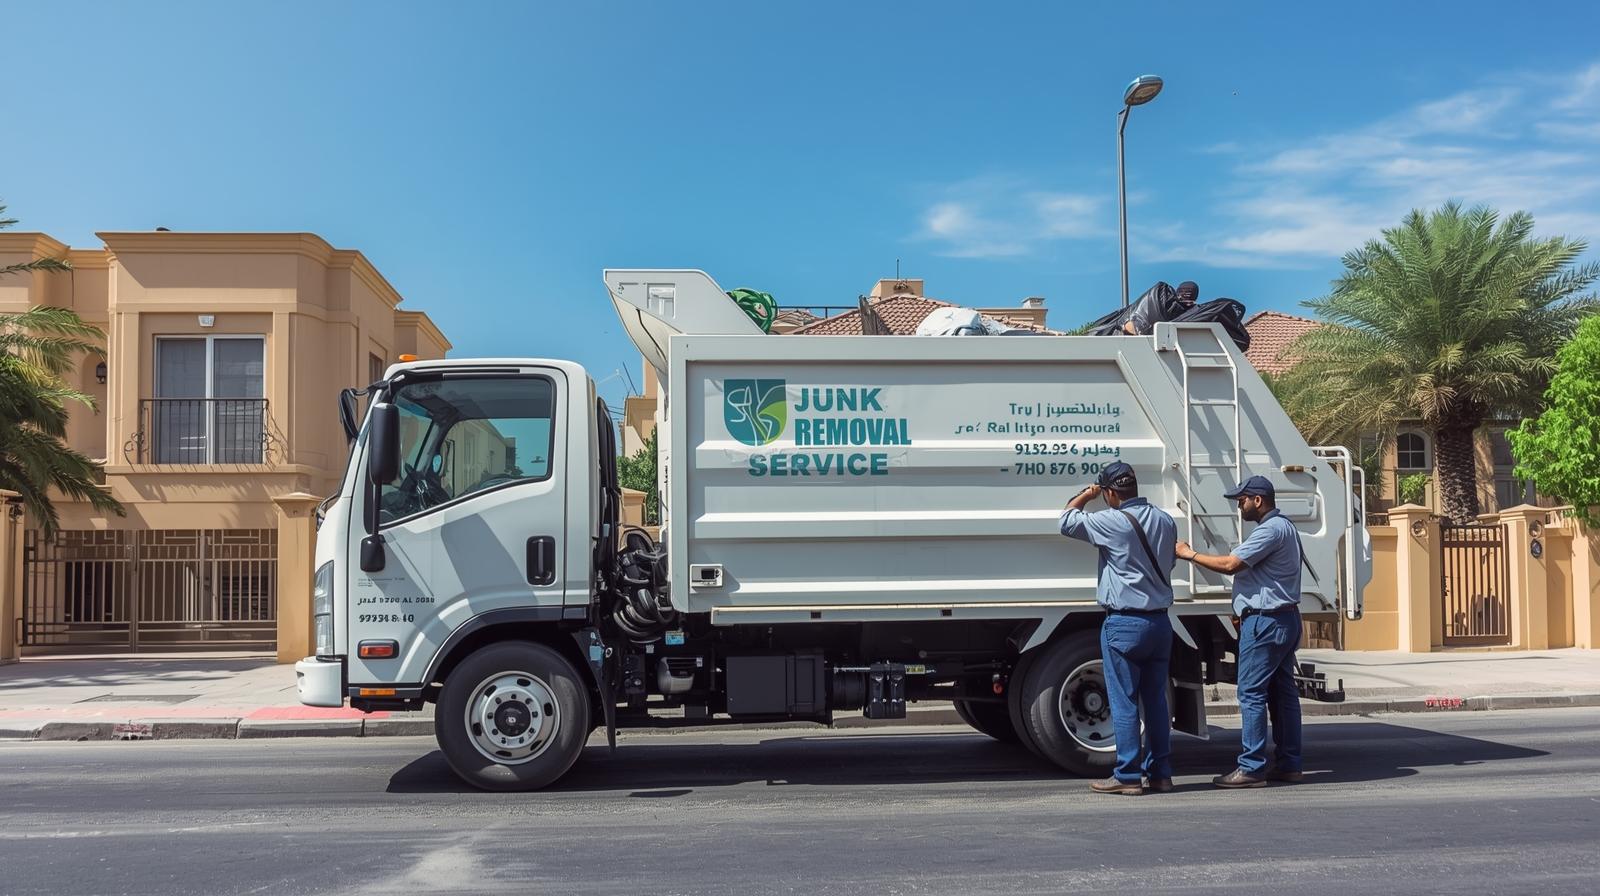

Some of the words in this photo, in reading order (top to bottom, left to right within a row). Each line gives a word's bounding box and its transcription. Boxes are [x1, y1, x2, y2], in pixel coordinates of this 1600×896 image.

[794, 388, 883, 412] JUNK
[794, 418, 912, 446] REMOVAL
[748, 453, 889, 477] SERVICE
[1050, 462, 1076, 475] 876
